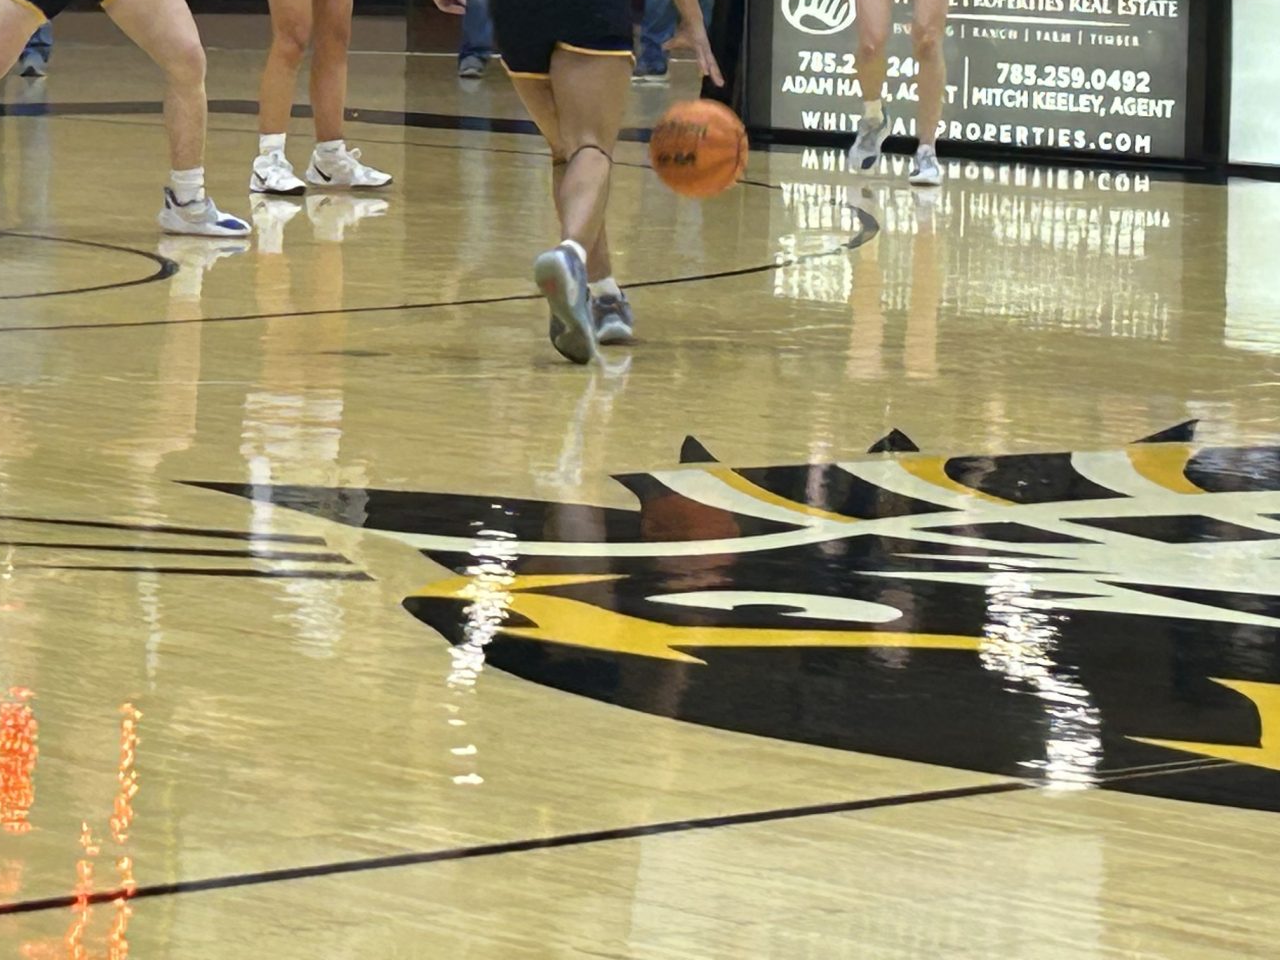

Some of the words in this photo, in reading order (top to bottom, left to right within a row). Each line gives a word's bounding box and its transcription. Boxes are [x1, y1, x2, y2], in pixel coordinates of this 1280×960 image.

[782, 75, 834, 96] ADAM
[996, 62, 1152, 93] 785.259.0492
[972, 86, 1029, 108] MITCH
[1032, 91, 1106, 117] KEELEY,
[1110, 99, 1176, 119] AGENT
